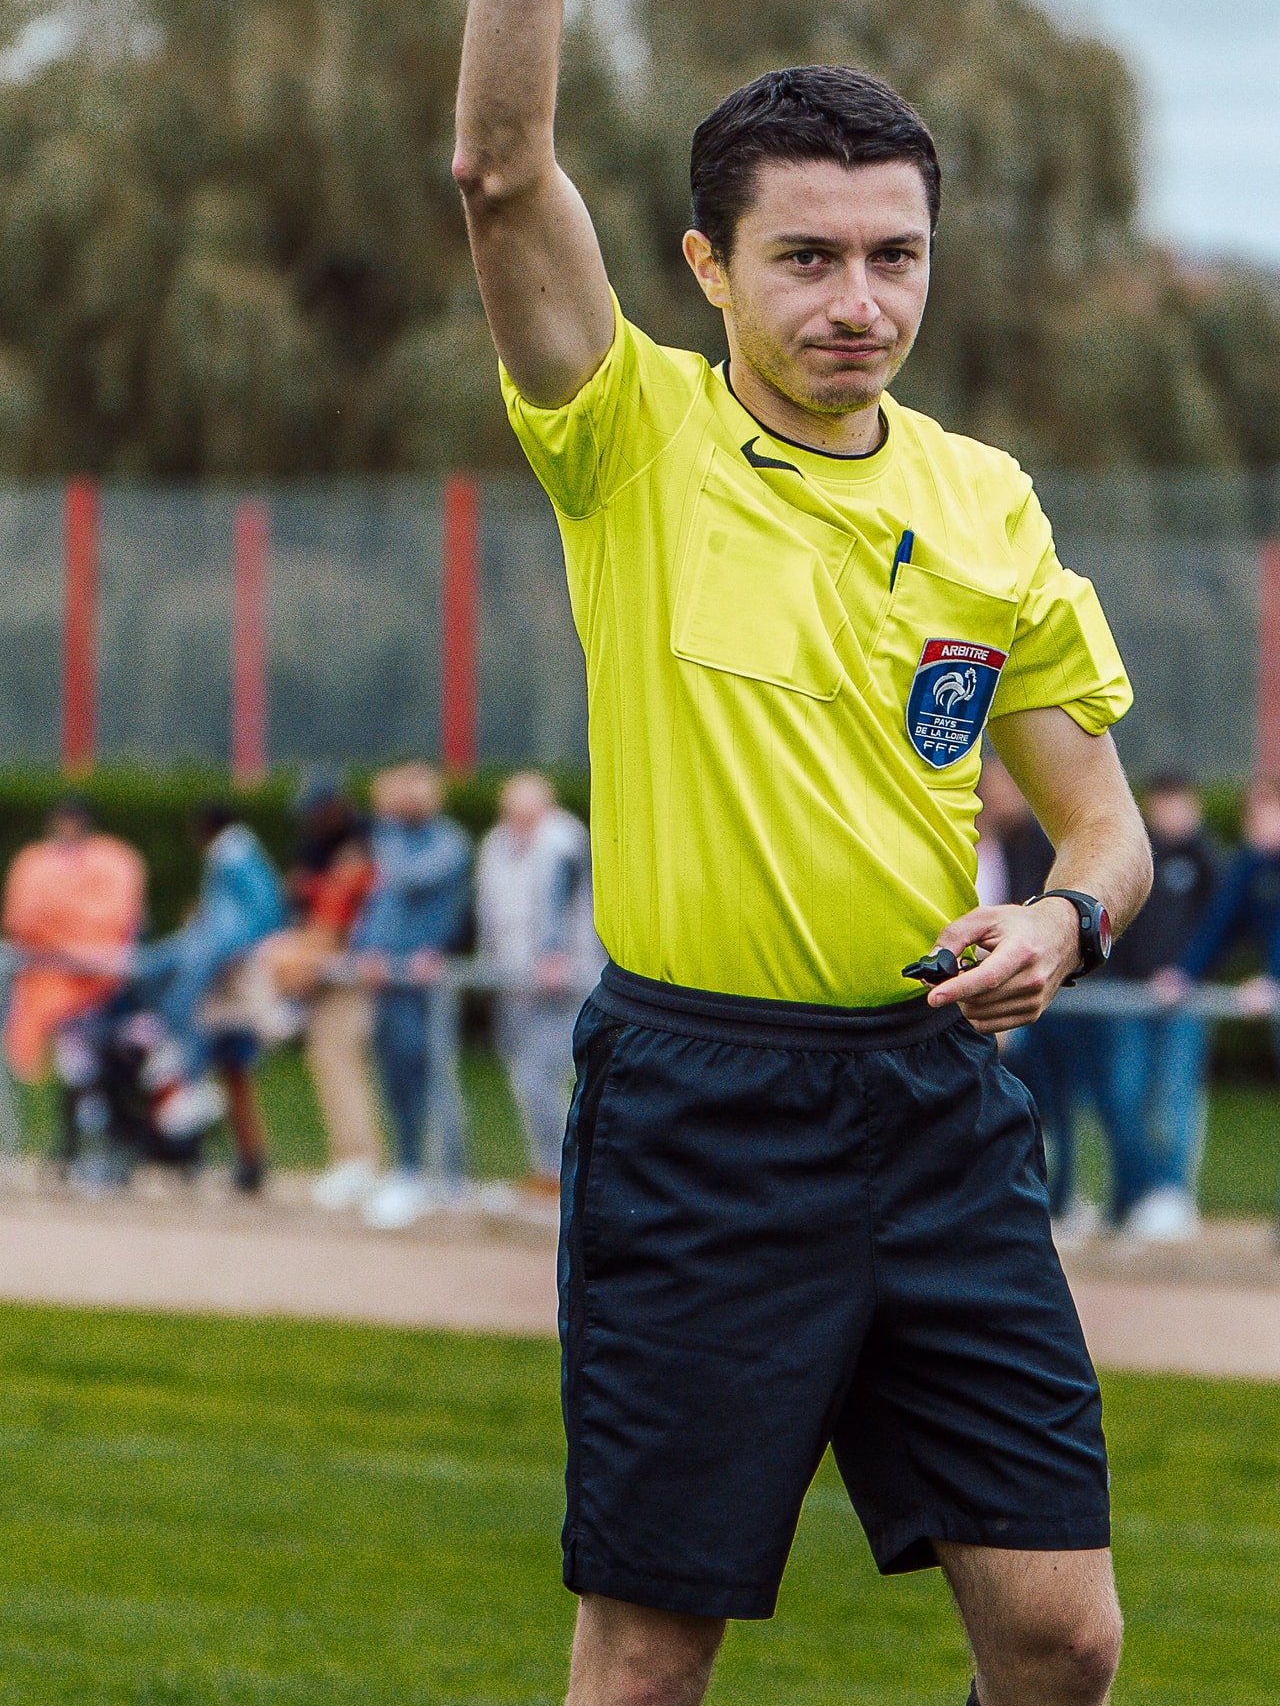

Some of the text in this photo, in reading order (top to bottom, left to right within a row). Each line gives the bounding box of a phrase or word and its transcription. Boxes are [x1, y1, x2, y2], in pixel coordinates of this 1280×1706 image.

[941, 644, 990, 661] ARBITRE
[934, 717, 957, 728] PAYS
[915, 725, 969, 742] DE LA LOIRE
[923, 740, 960, 754] FFF
